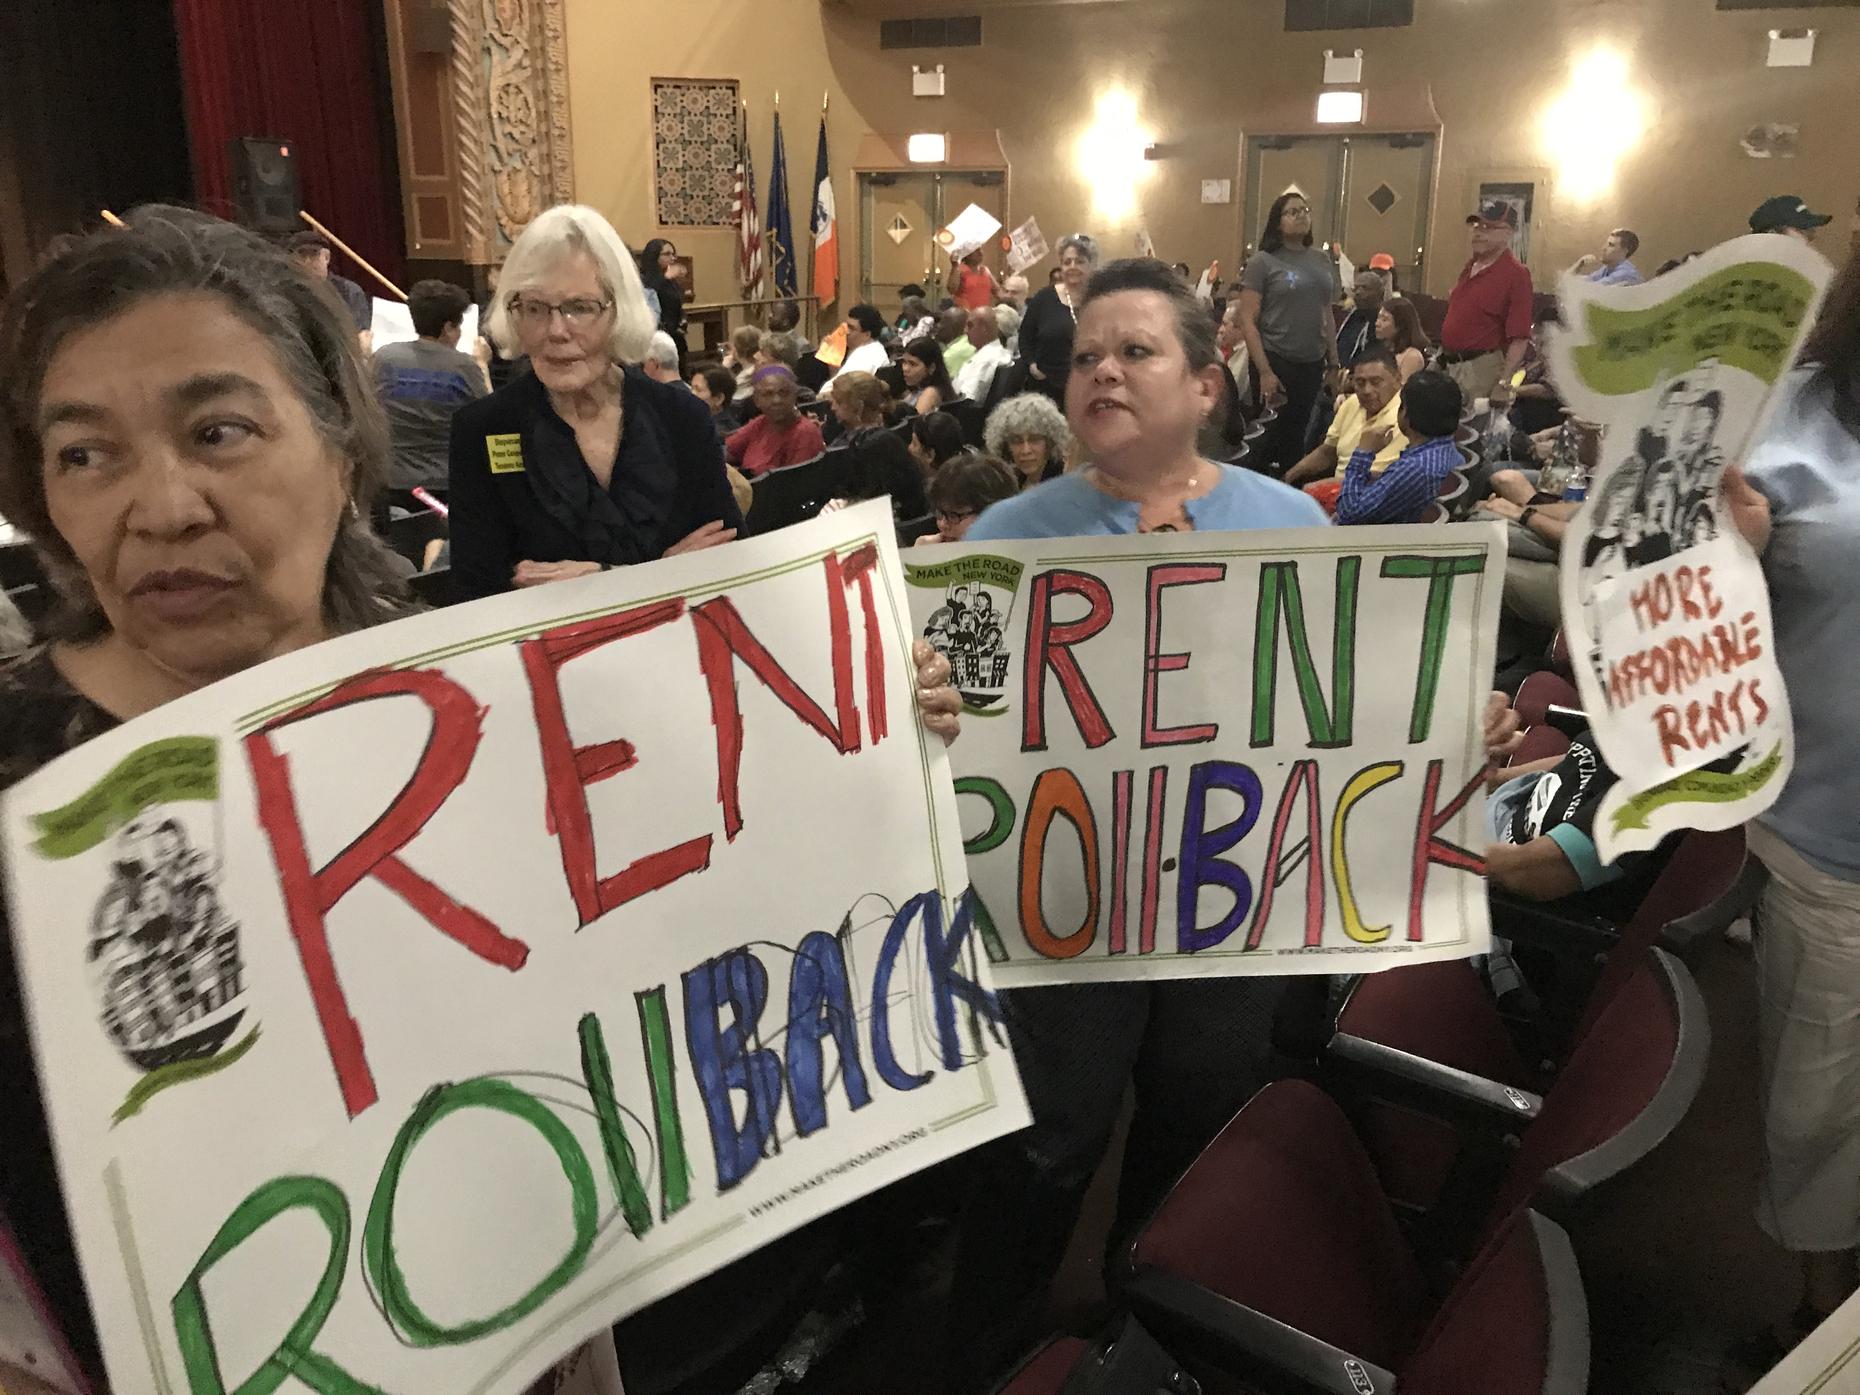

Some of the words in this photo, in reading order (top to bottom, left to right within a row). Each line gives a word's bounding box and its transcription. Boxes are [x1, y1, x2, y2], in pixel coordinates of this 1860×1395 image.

[916, 566, 952, 579] MAKE
[953, 558, 983, 572] THE
[983, 559, 1020, 576] ROAD
[962, 570, 988, 581] NEW
[990, 572, 1015, 586] YORK
[1629, 565, 1723, 633] MORE
[1020, 555, 1487, 752] RENT
[242, 543, 887, 1122] RENT
